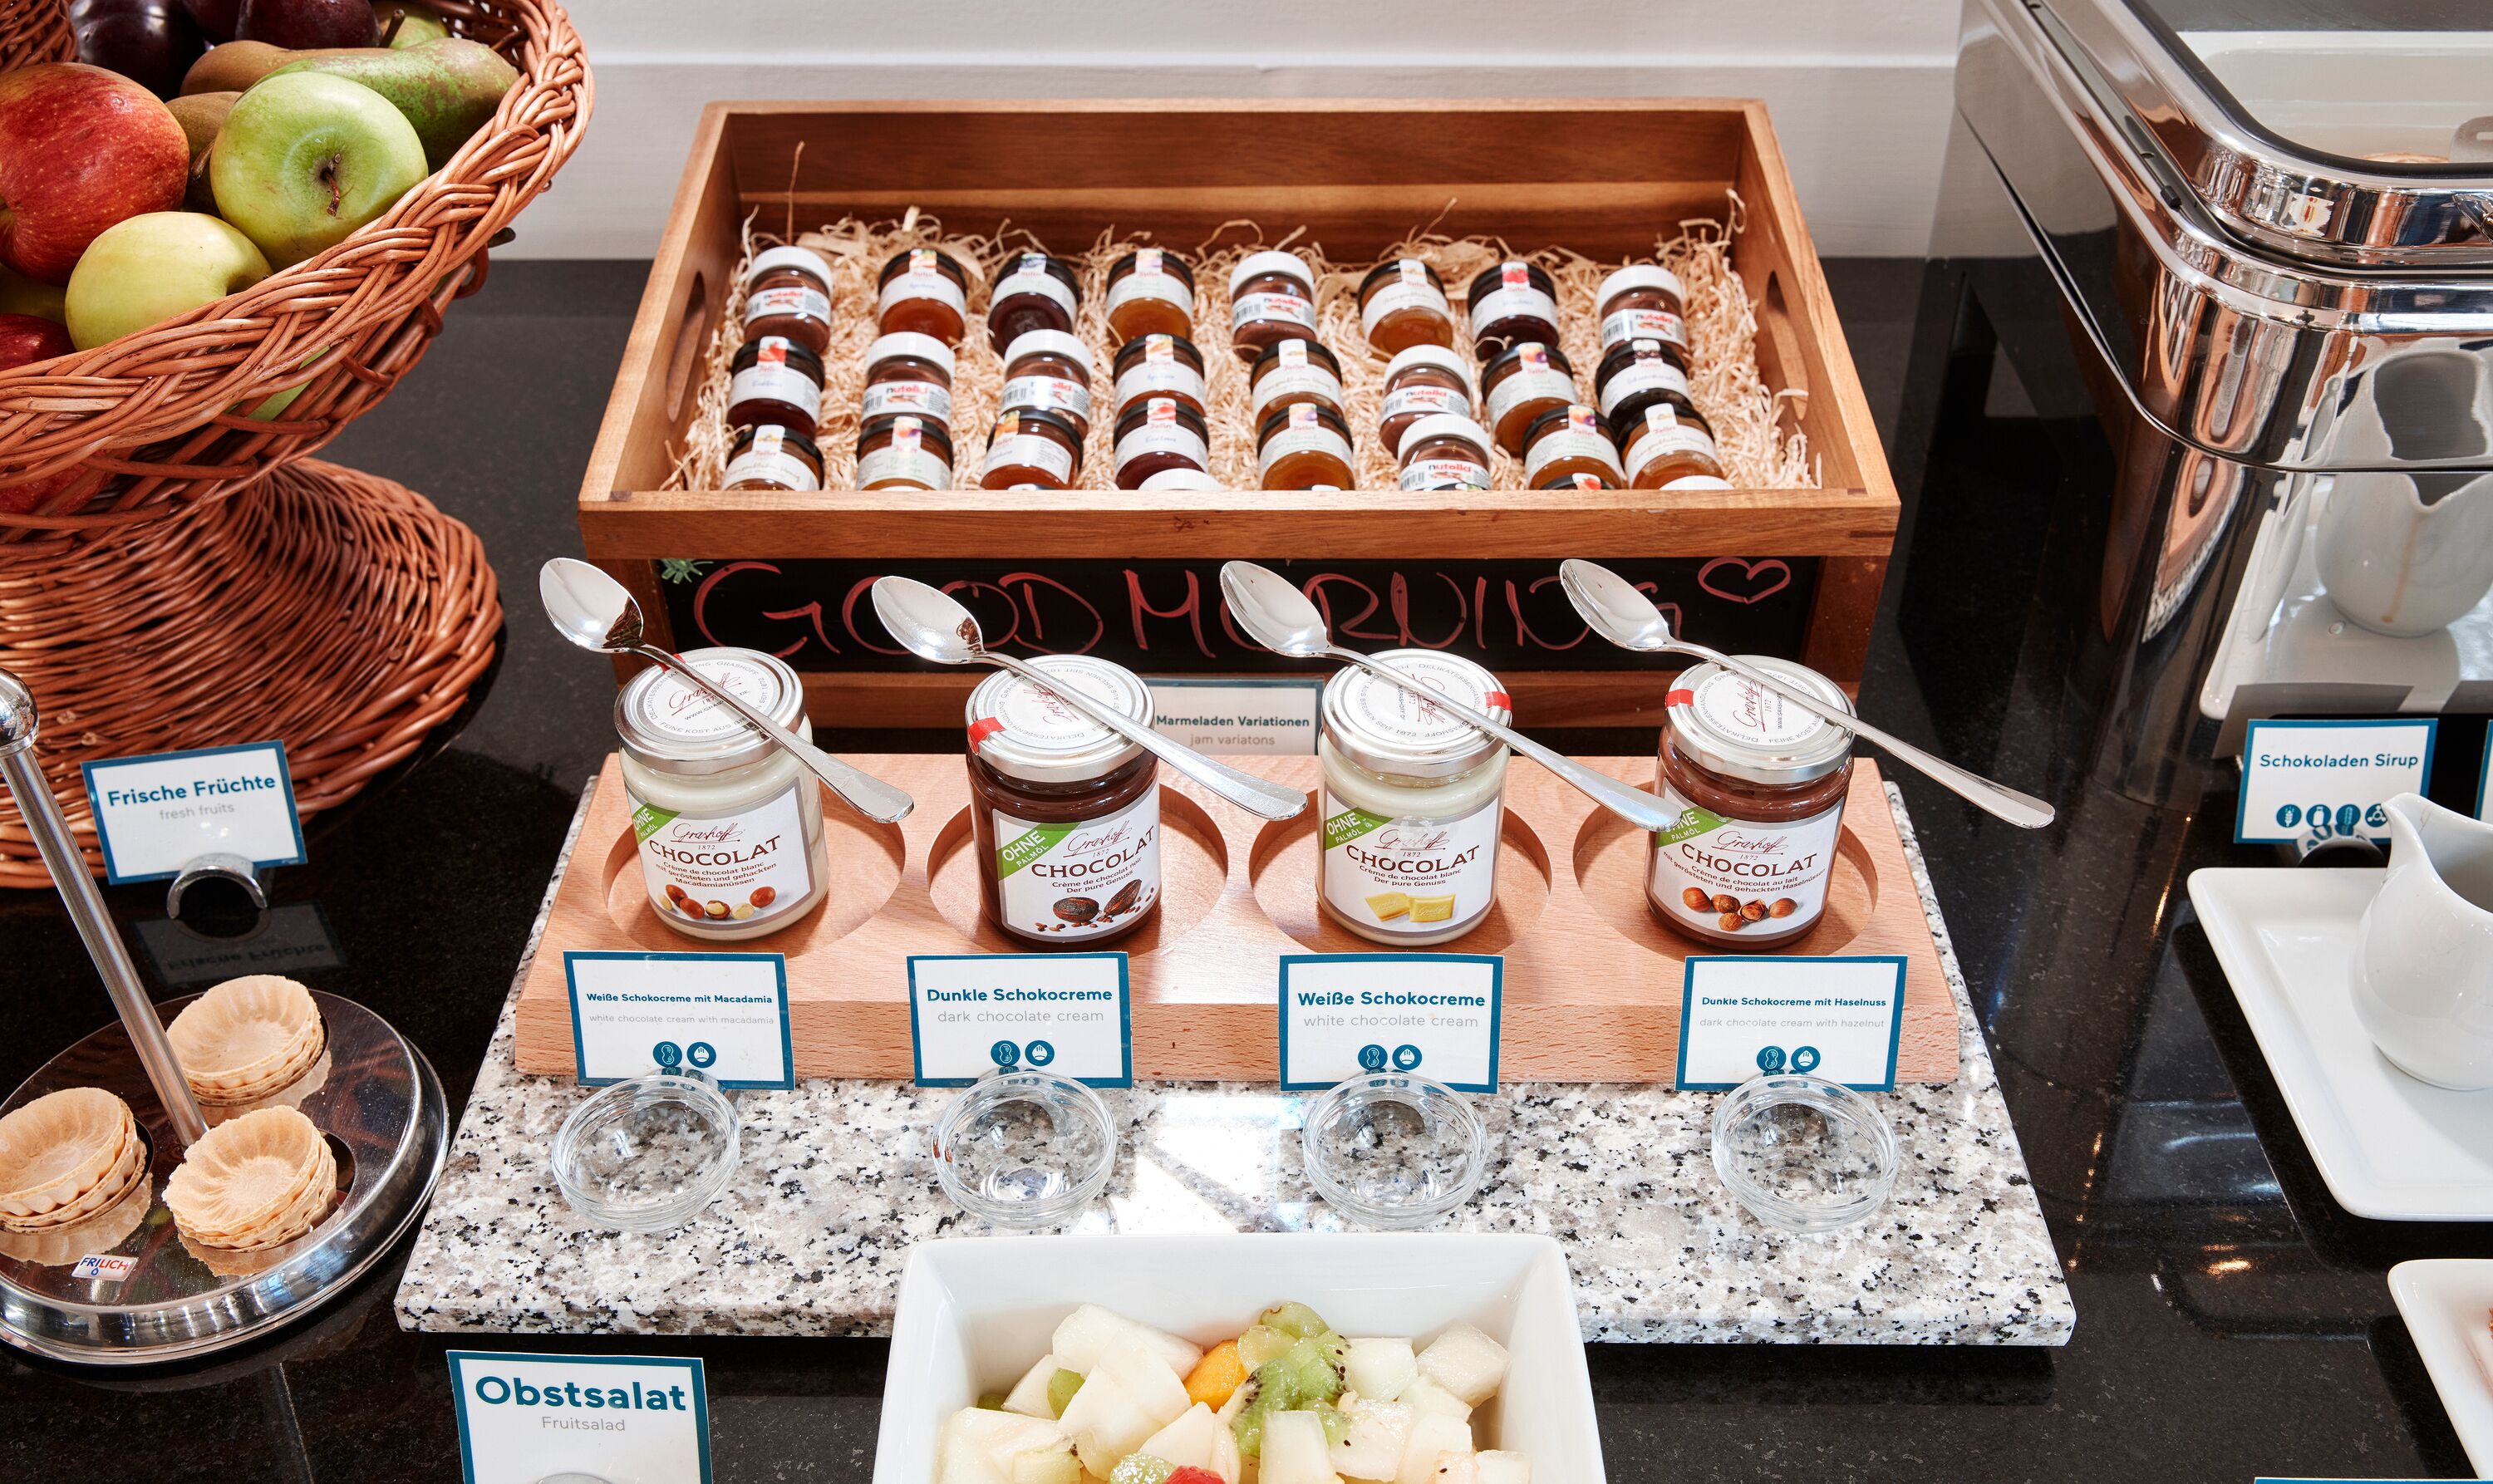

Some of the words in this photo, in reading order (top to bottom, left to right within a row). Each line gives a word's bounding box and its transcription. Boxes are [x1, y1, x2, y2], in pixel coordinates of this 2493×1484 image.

[1157, 715, 1234, 726] Marmeladen
[1238, 716, 1310, 726] Variationen
[1190, 735, 1213, 746] jam
[1217, 735, 1276, 744] variatons
[2259, 754, 2368, 768] Schokoladen
[2375, 754, 2418, 769] Sirup
[107, 785, 187, 807] Frische
[193, 775, 276, 798] Früchte
[160, 806, 195, 821] fresh
[199, 802, 234, 816] fruits
[1326, 812, 1361, 835] OHNE
[672, 823, 743, 843] Grashoff
[1068, 820, 1133, 856] Grashoff
[1335, 828, 1363, 843] PALMÖL
[1671, 827, 1700, 841] PALMÖL
[1002, 830, 1045, 862] OHNE
[1717, 831, 1788, 853] Grashoff
[649, 835, 780, 866] CHOCOLAT
[1016, 844, 1050, 867] PALMÖL
[1031, 825, 1154, 877] CHOCOLAT
[1093, 849, 1109, 857] 1872
[1346, 844, 1480, 873] CHOCOLAT
[664, 862, 687, 873] Crème
[741, 862, 765, 872] blanc
[1682, 843, 1817, 877] CHOCOLAT
[656, 863, 666, 872] mit
[669, 870, 711, 882] gerösteten
[733, 863, 777, 881] gehackten
[1096, 866, 1128, 882] chocolat
[1129, 857, 1143, 868] noir
[1360, 865, 1385, 877] Crème
[1440, 868, 1462, 878] blanc
[1663, 851, 1674, 863] mit
[1674, 861, 1714, 885] gerösteten
[1715, 882, 1733, 890] und
[1691, 865, 1718, 880] Crème
[676, 877, 755, 887] Macadamianüssen
[1084, 885, 1104, 893] pure
[1106, 870, 1133, 886] Genuss
[586, 993, 618, 1002] Weiße
[622, 994, 691, 1003] Schokocreme
[695, 995, 711, 1003] mit
[715, 995, 772, 1004] Macadamia
[927, 989, 988, 1001] Dunkle
[993, 989, 1112, 1001] Schokocreme
[1298, 991, 1355, 1006] Weiße
[1360, 991, 1486, 1007] Schokocreme
[1702, 997, 1738, 1005] Dunkle
[1741, 997, 1811, 1006] Schokocreme
[1814, 998, 1832, 1006] mit
[1835, 998, 1886, 1006] Haselnuss
[589, 1015, 615, 1023] white
[617, 1015, 663, 1023] chocolate
[698, 1015, 718, 1024] with
[720, 1016, 774, 1025] macadamia
[937, 1010, 971, 1022] dark
[976, 1010, 1051, 1022] chocolate
[1057, 1012, 1104, 1022] cream
[1304, 1014, 1345, 1026] white
[1350, 1015, 1425, 1026] chocolate
[1431, 1017, 1478, 1028] cream
[1699, 1018, 1722, 1026] dark
[1726, 1018, 1777, 1027] chocolate
[1816, 1019, 1837, 1028] with
[1841, 1019, 1885, 1028] hazelnut
[80, 1257, 130, 1271] FRILICH
[475, 1376, 686, 1411] Obstsalat
[542, 1416, 626, 1432] Fruitsalad
